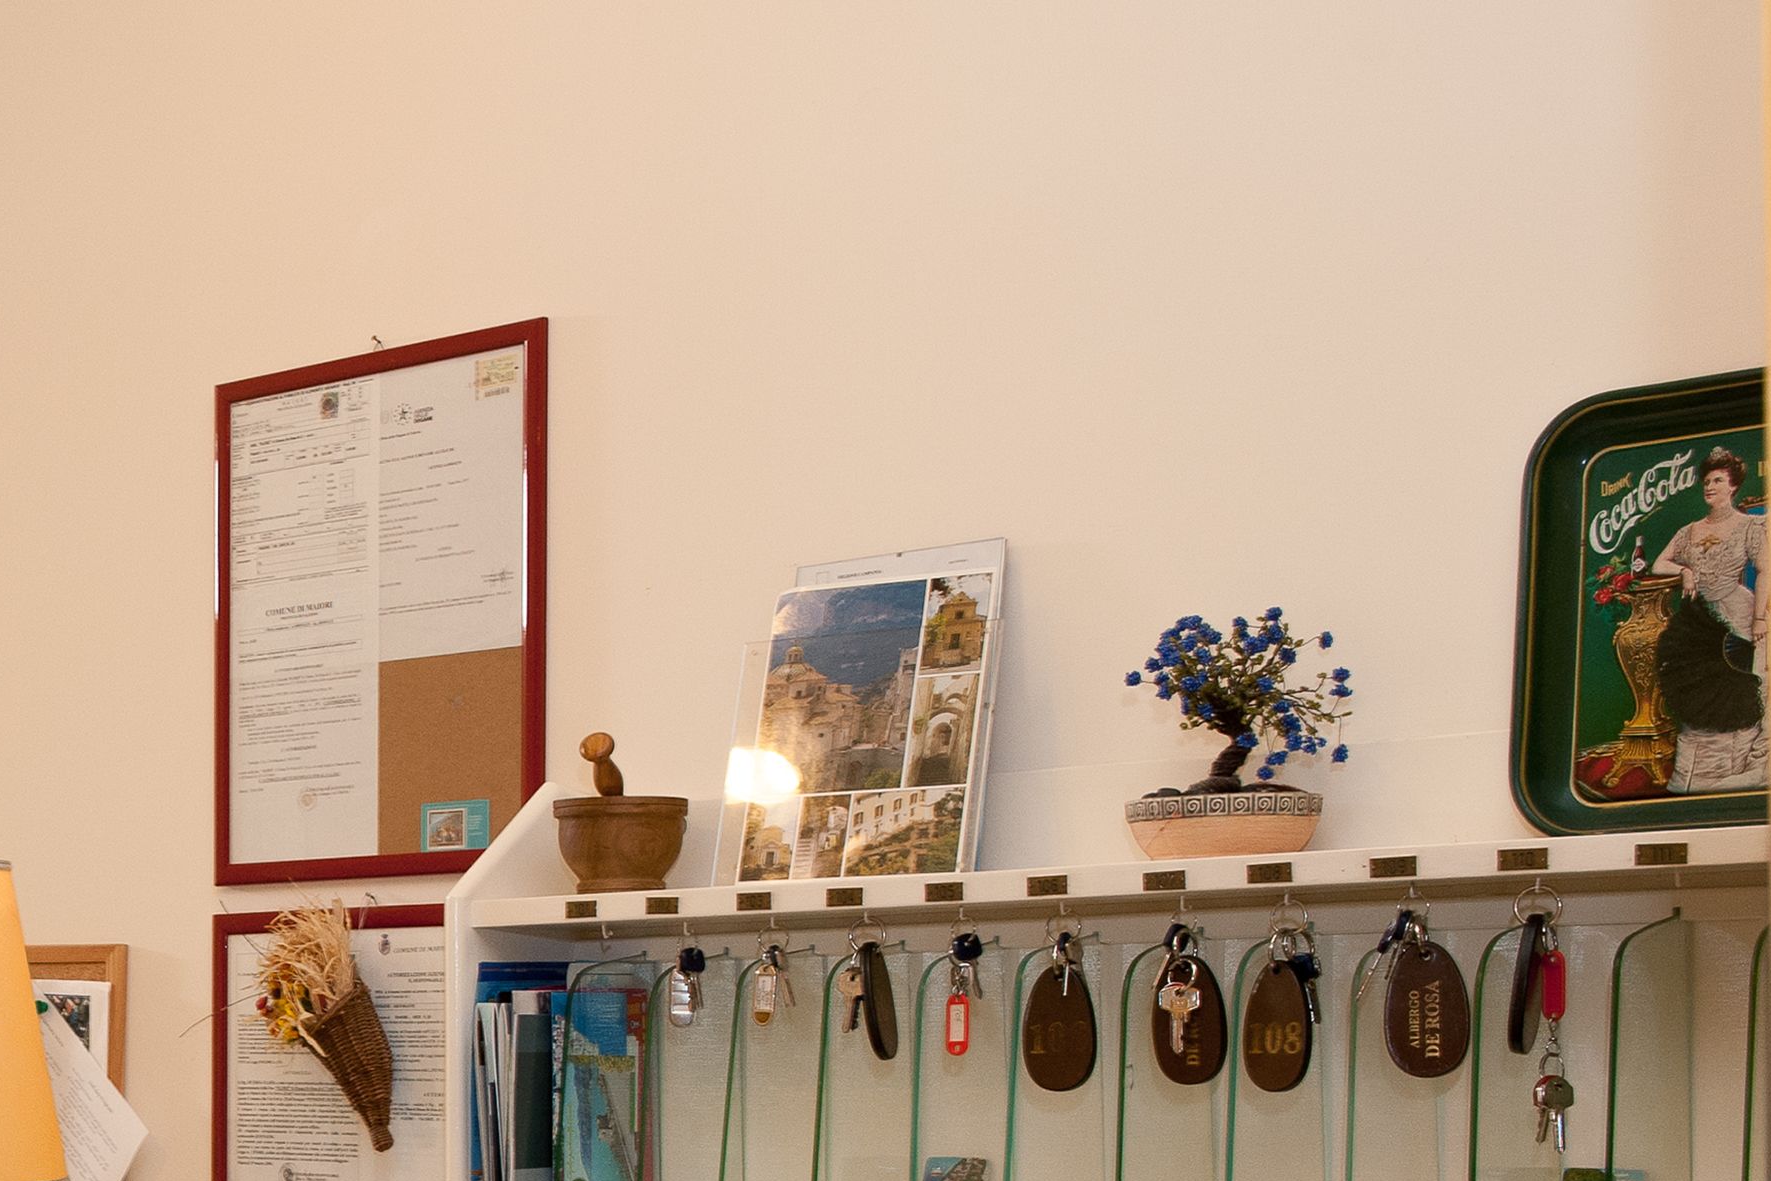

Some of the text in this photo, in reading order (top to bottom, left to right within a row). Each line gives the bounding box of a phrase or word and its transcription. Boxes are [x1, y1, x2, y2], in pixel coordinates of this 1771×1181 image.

[1589, 449, 1696, 555] Coca-Cola
[1248, 1021, 1303, 1056] 108
[1408, 990, 1420, 1049] ALBERGO
[1424, 980, 1441, 1058] DE ROSA
